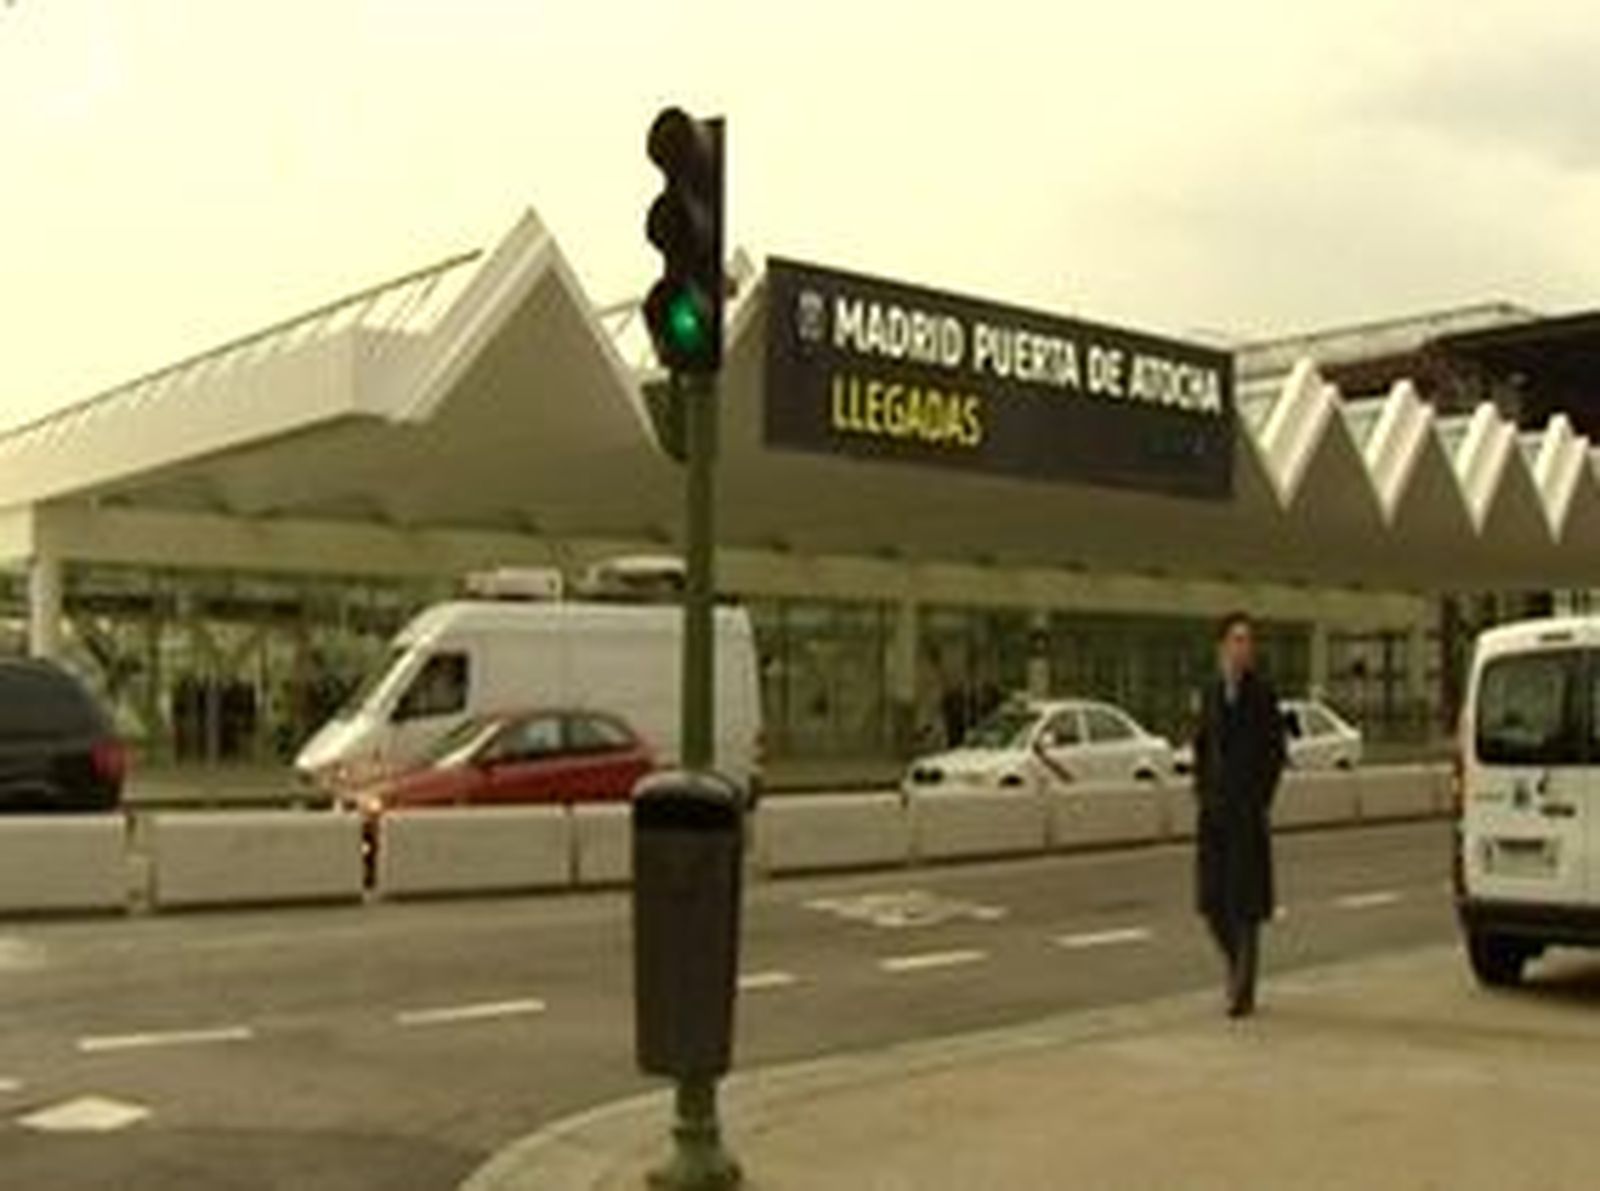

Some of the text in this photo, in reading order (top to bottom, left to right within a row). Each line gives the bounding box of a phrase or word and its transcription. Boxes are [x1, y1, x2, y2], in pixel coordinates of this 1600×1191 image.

[834, 298, 1222, 413] MADRID PUERTA DE ATOCHA
[832, 375, 981, 446] LLEGADAS
